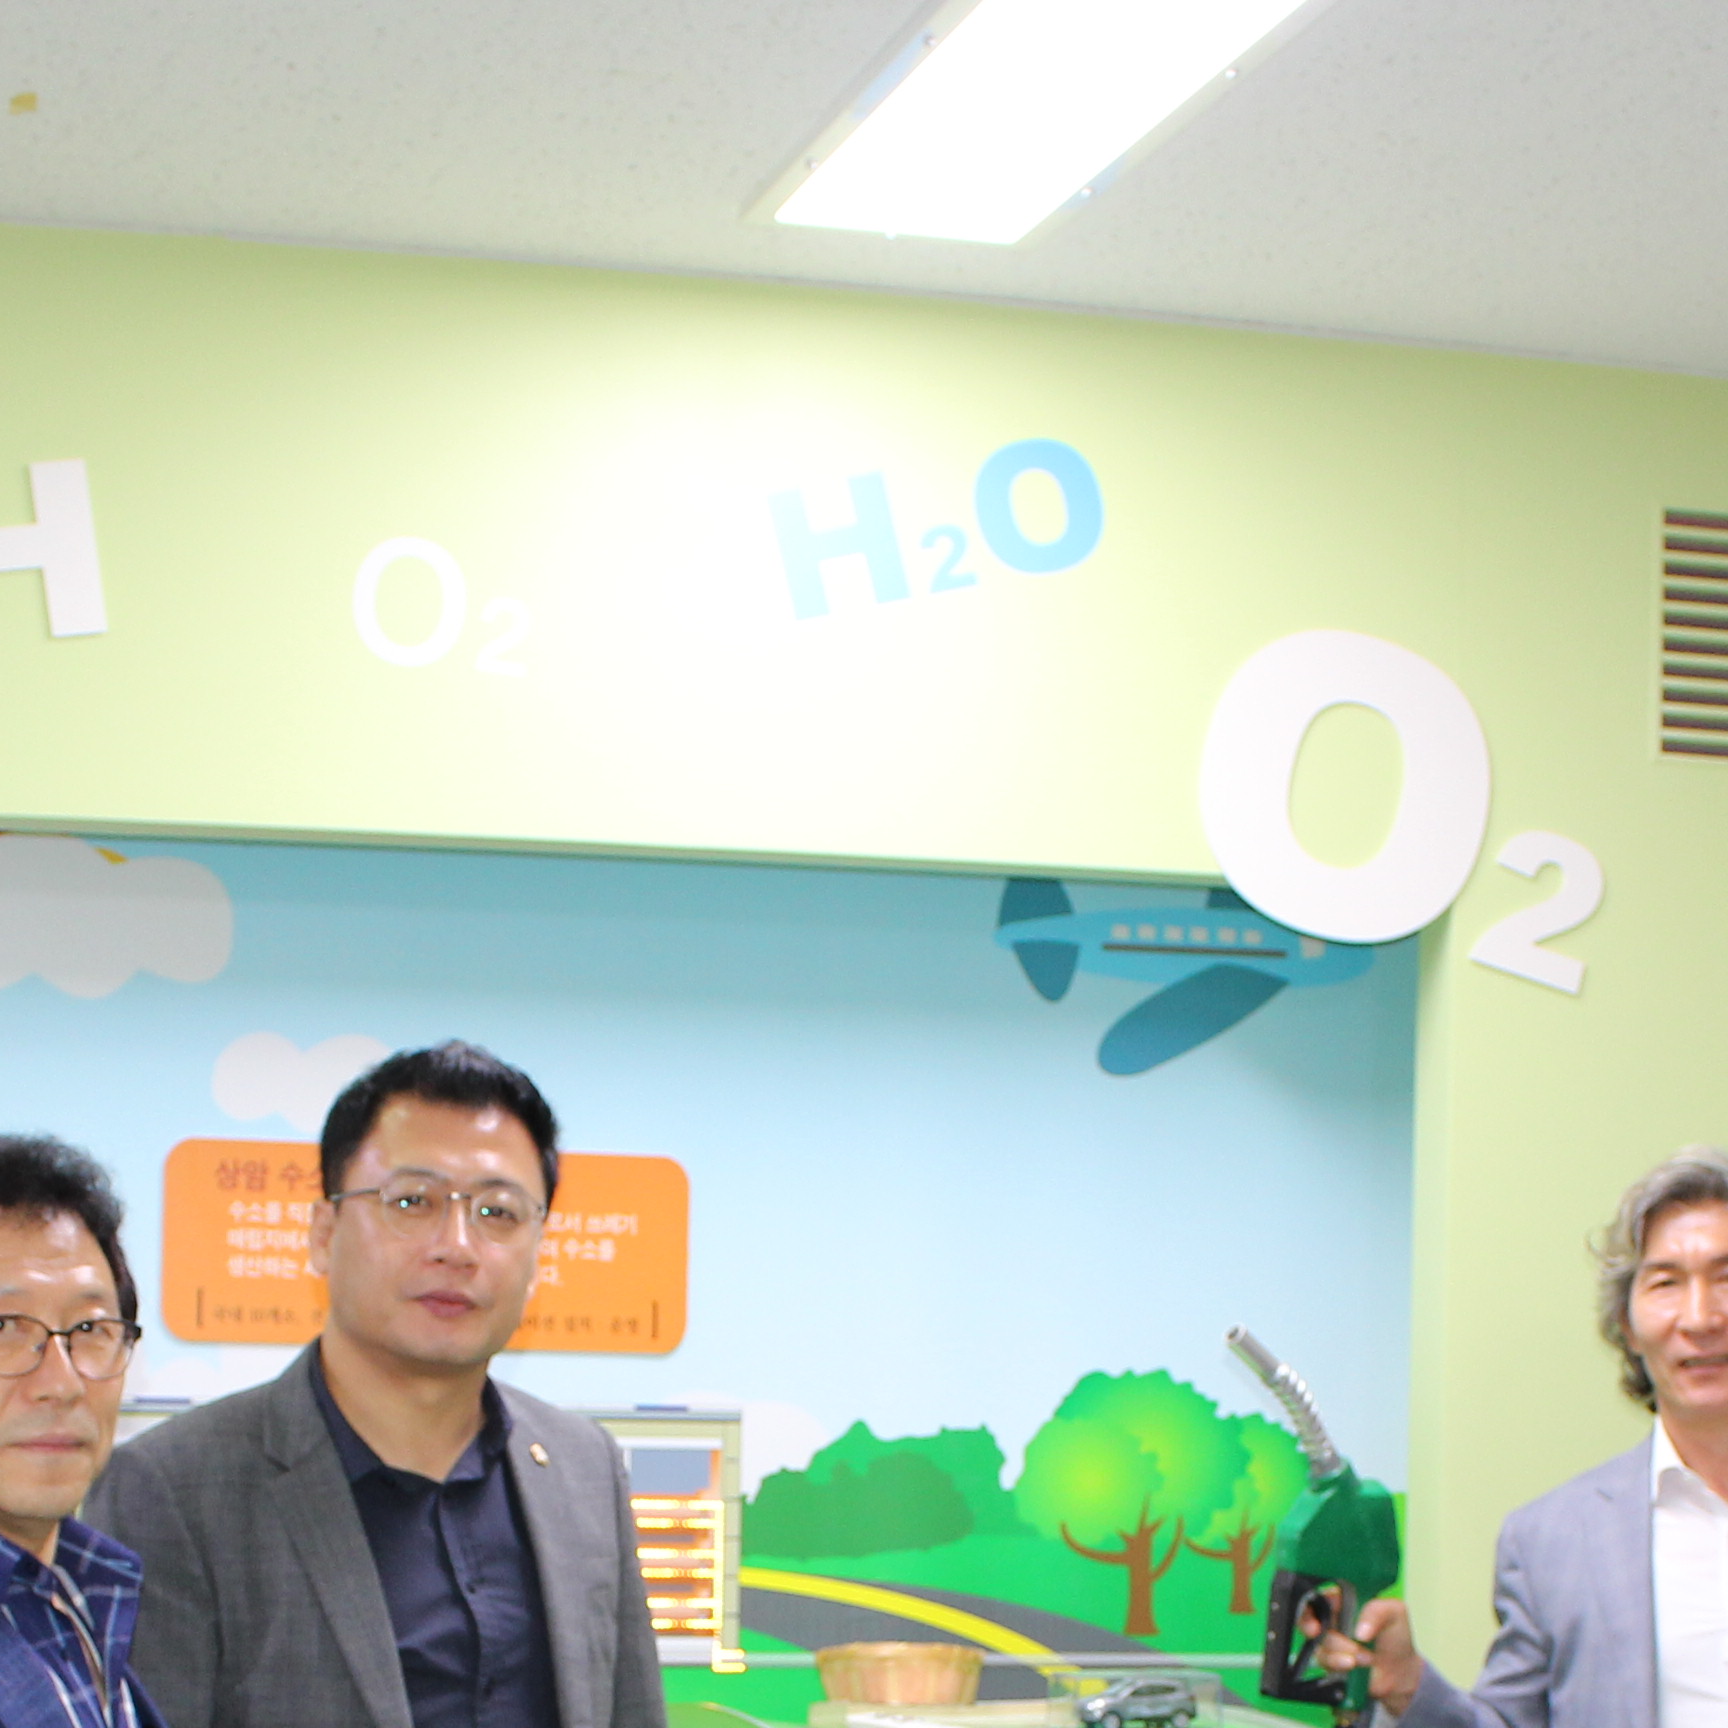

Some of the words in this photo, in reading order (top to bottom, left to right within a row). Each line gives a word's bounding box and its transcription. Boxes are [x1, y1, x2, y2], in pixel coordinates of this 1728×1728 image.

[768, 436, 1104, 621] H2O
[351, 536, 532, 680] O2
[1198, 627, 1605, 997] O2
[228, 1200, 282, 1225] 수소를
[563, 1239, 616, 1263] 수소를
